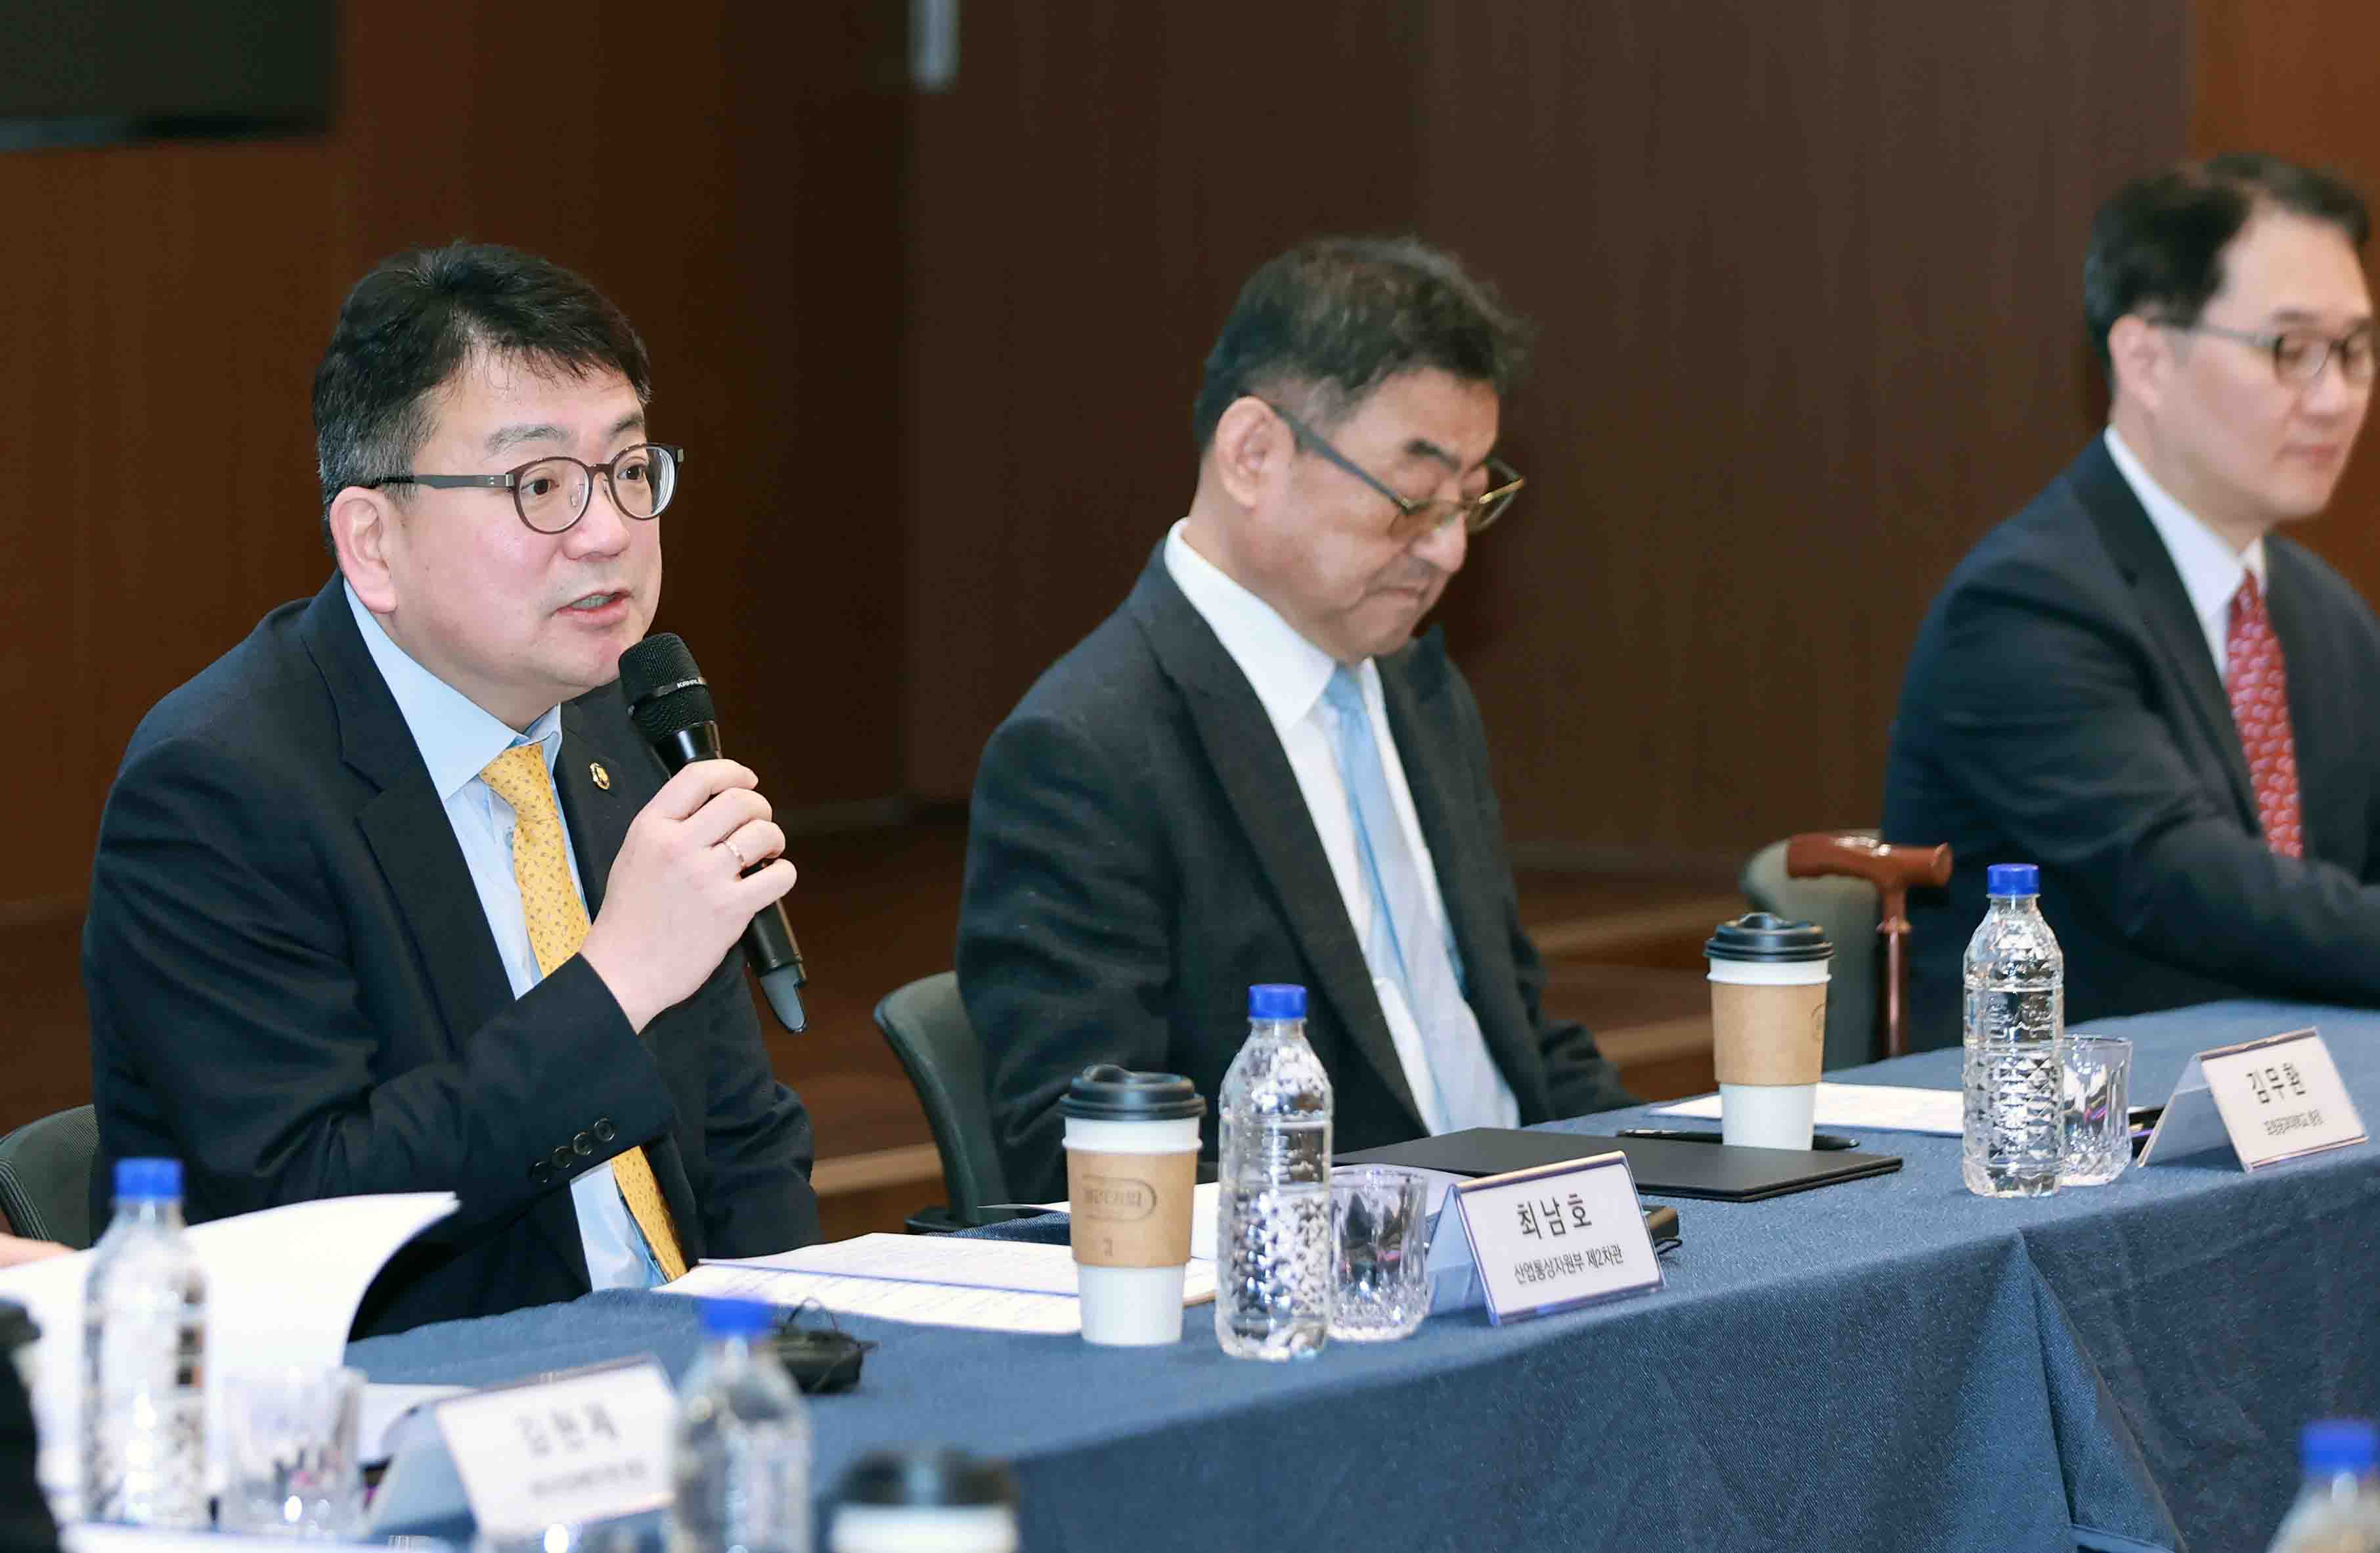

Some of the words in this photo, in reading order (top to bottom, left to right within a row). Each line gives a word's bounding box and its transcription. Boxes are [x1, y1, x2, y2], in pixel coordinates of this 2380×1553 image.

[2246, 1062, 2306, 1104] 김무환
[1516, 1192, 1593, 1240] 최남호
[1514, 1251, 1585, 1284] 산업통상자원부
[1586, 1244, 1625, 1269] 제2차관
